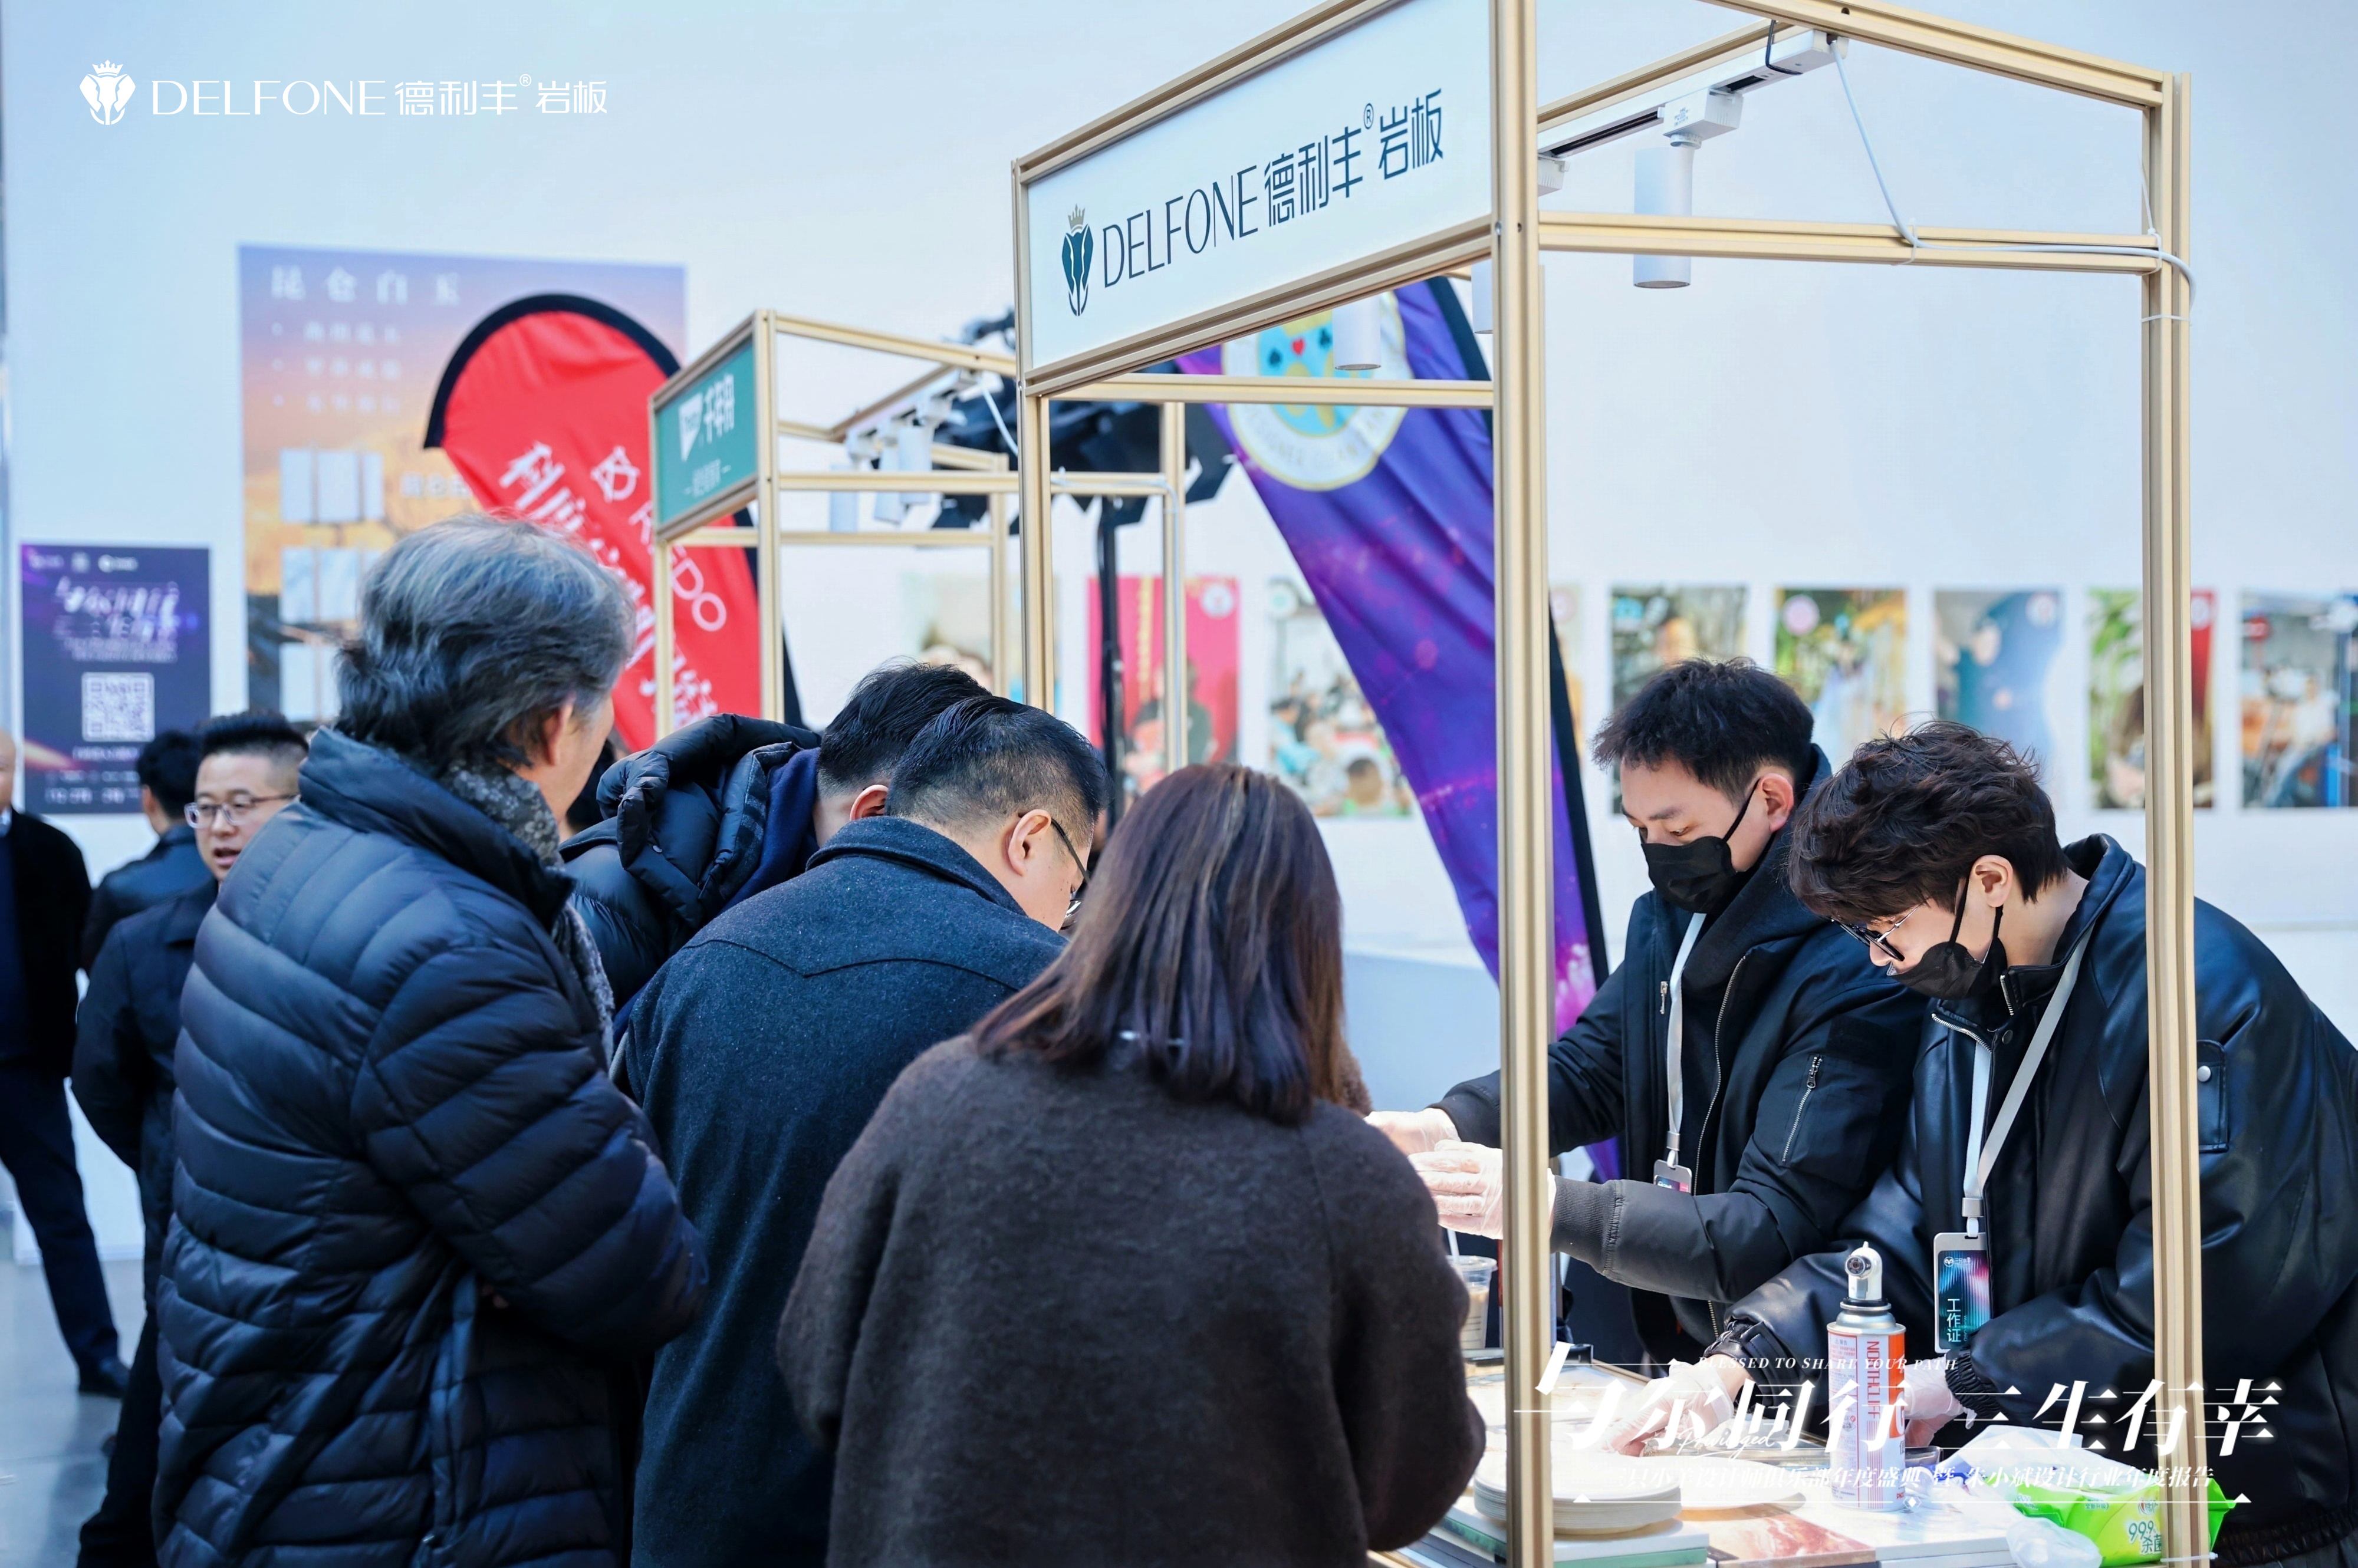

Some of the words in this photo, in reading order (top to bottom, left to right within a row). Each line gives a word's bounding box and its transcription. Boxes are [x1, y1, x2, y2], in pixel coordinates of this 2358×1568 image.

[1102, 164, 1258, 288] DELFONE
[1946, 1299, 1961, 1342] 工作证
[2142, 1534, 2162, 1553] 杀菌
